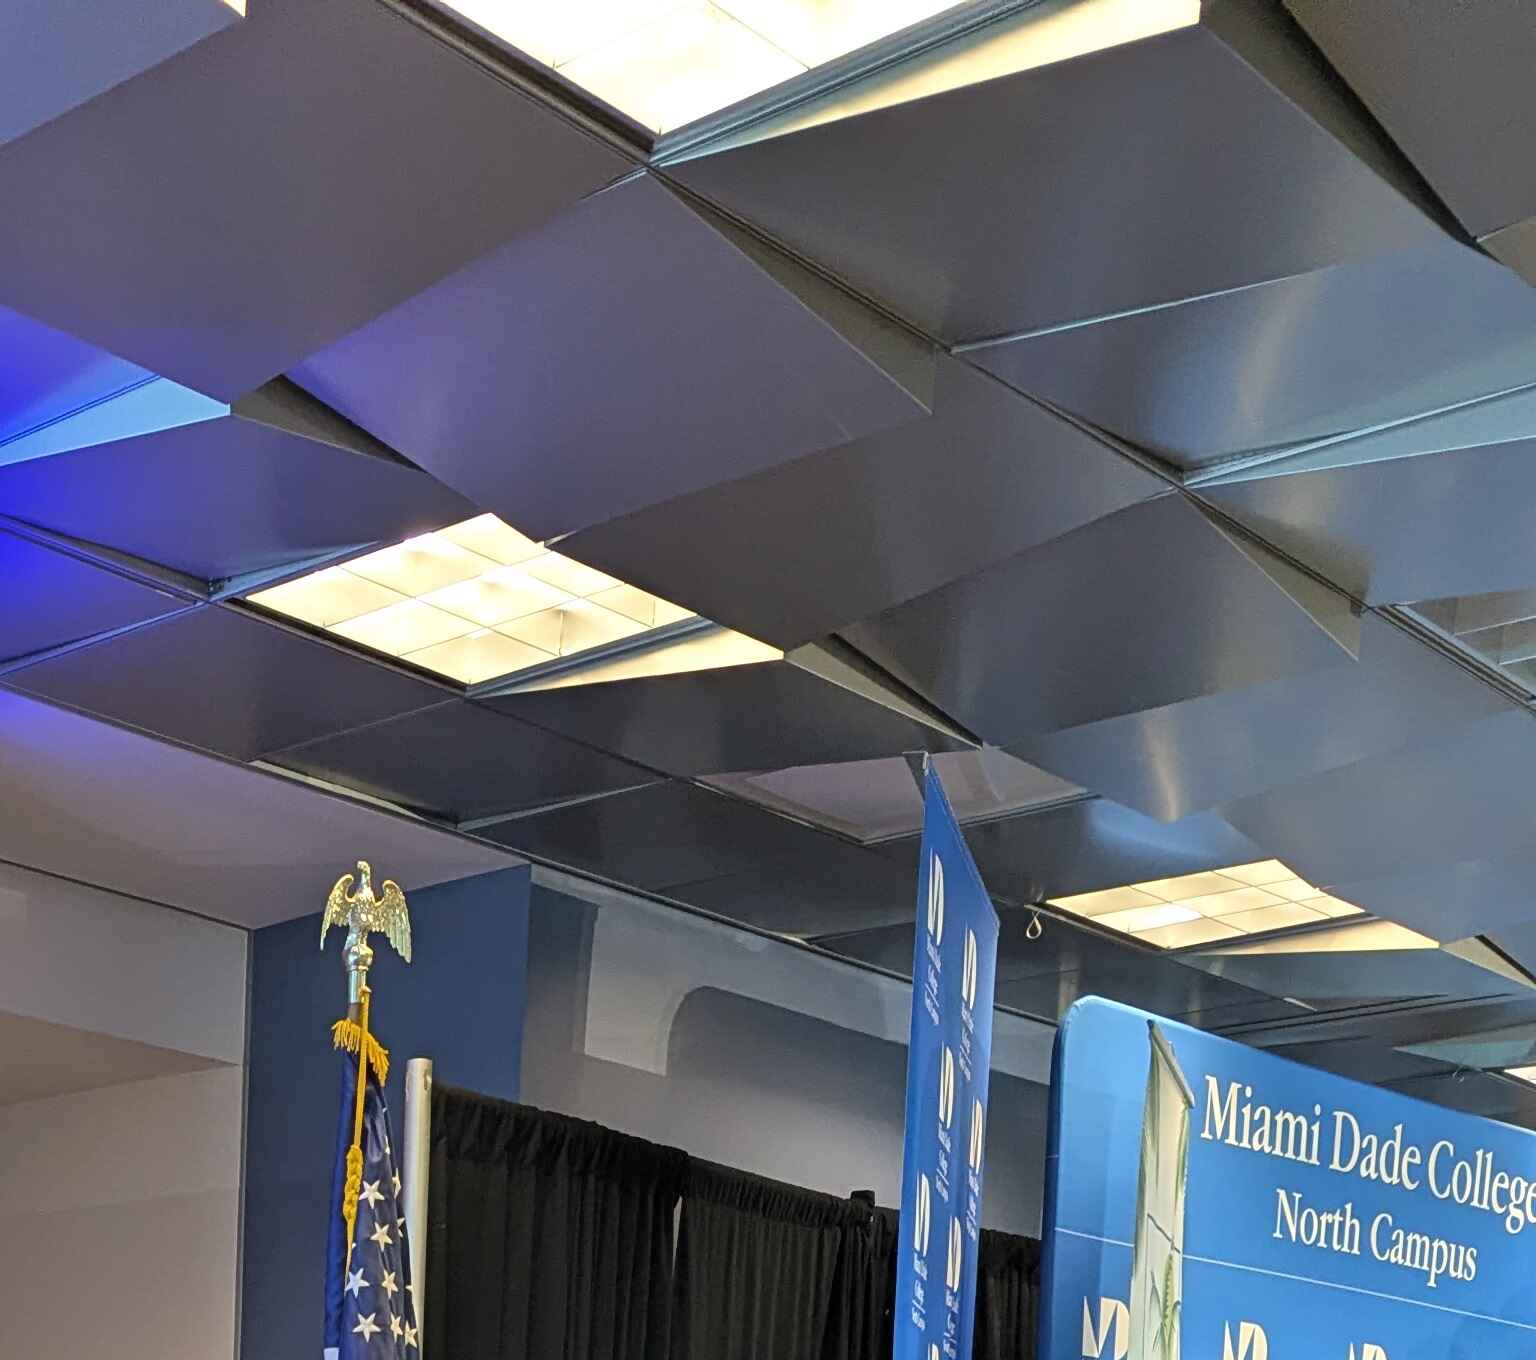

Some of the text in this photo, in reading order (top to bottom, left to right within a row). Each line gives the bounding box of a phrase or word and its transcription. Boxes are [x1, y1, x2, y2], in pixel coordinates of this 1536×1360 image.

[1200, 1074, 1321, 1166] Miami
[1329, 1110, 1421, 1191] Dade
[1273, 1188, 1477, 1288] North Campus
